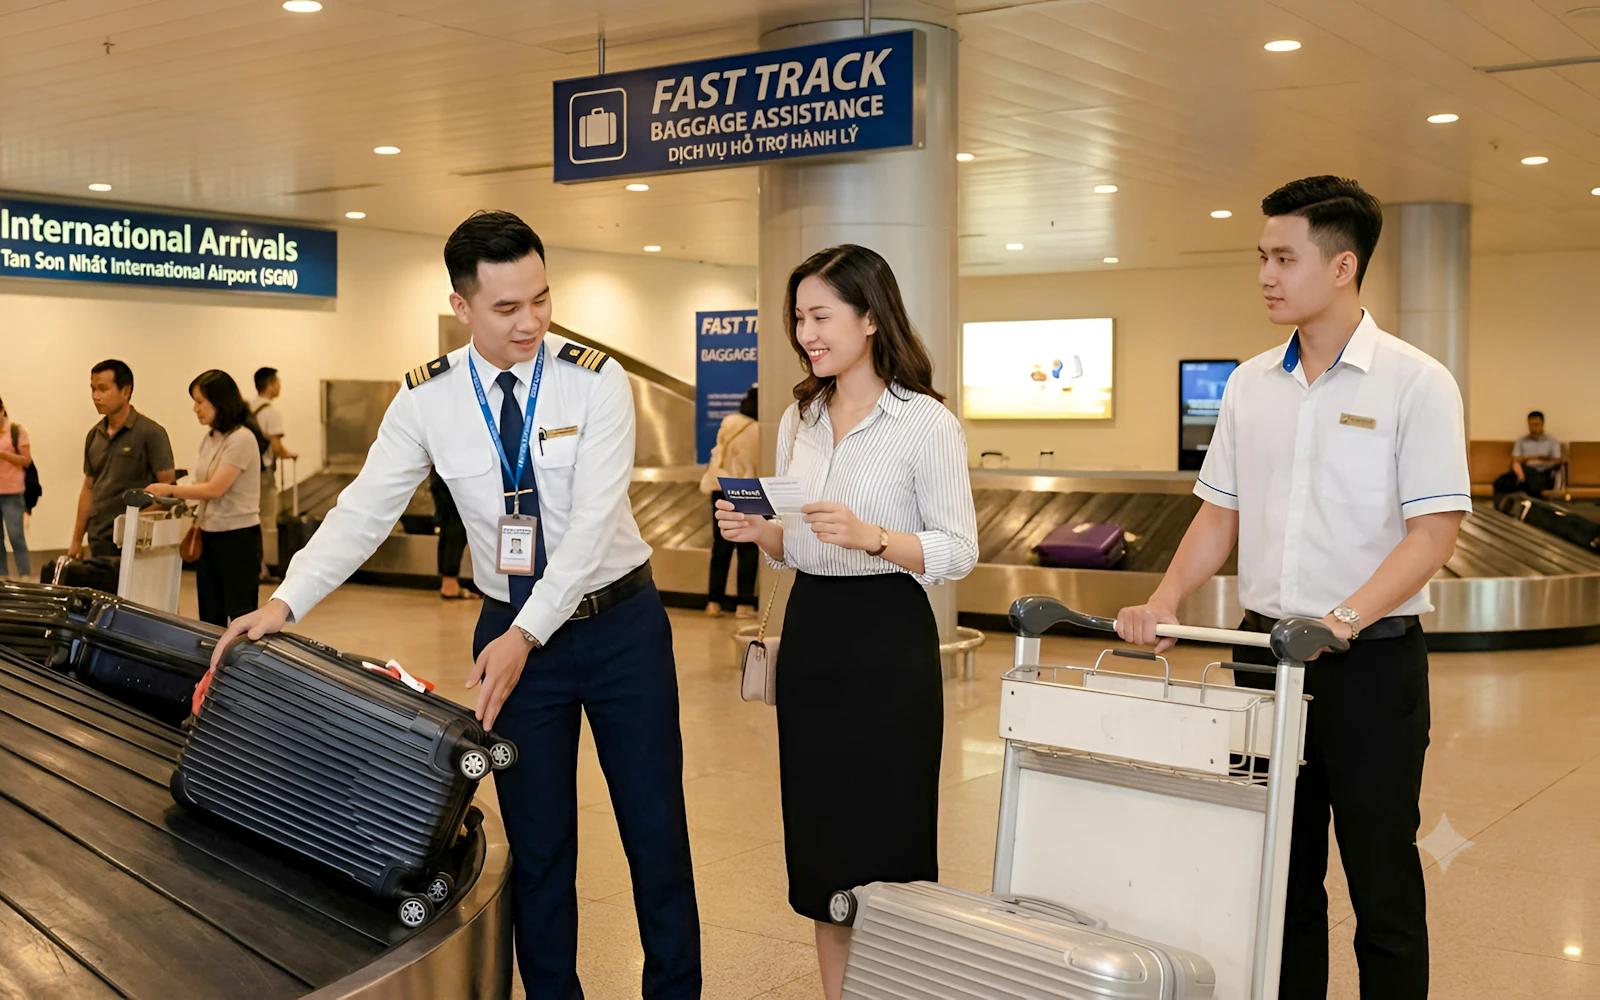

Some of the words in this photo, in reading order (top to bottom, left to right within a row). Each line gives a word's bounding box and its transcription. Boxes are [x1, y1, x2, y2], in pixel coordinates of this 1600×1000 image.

[651, 68, 748, 115] FAST
[754, 47, 893, 101] TRACK
[651, 111, 748, 142] BAGGAGE
[751, 94, 884, 130] ASSISTANCE
[668, 143, 704, 165] DỊCH
[706, 141, 727, 161] VỤ
[756, 132, 789, 154] TRỢ
[791, 128, 837, 149] HÀNH
[0, 208, 192, 254] International
[198, 227, 299, 262] Arrivals
[1, 248, 31, 269] Tan
[34, 250, 65, 271] Son
[110, 256, 205, 280] International
[207, 263, 258, 286] Airport
[260, 267, 299, 290] (SGN)
[701, 316, 744, 335] FAST
[701, 347, 757, 362] BAGGAGE
